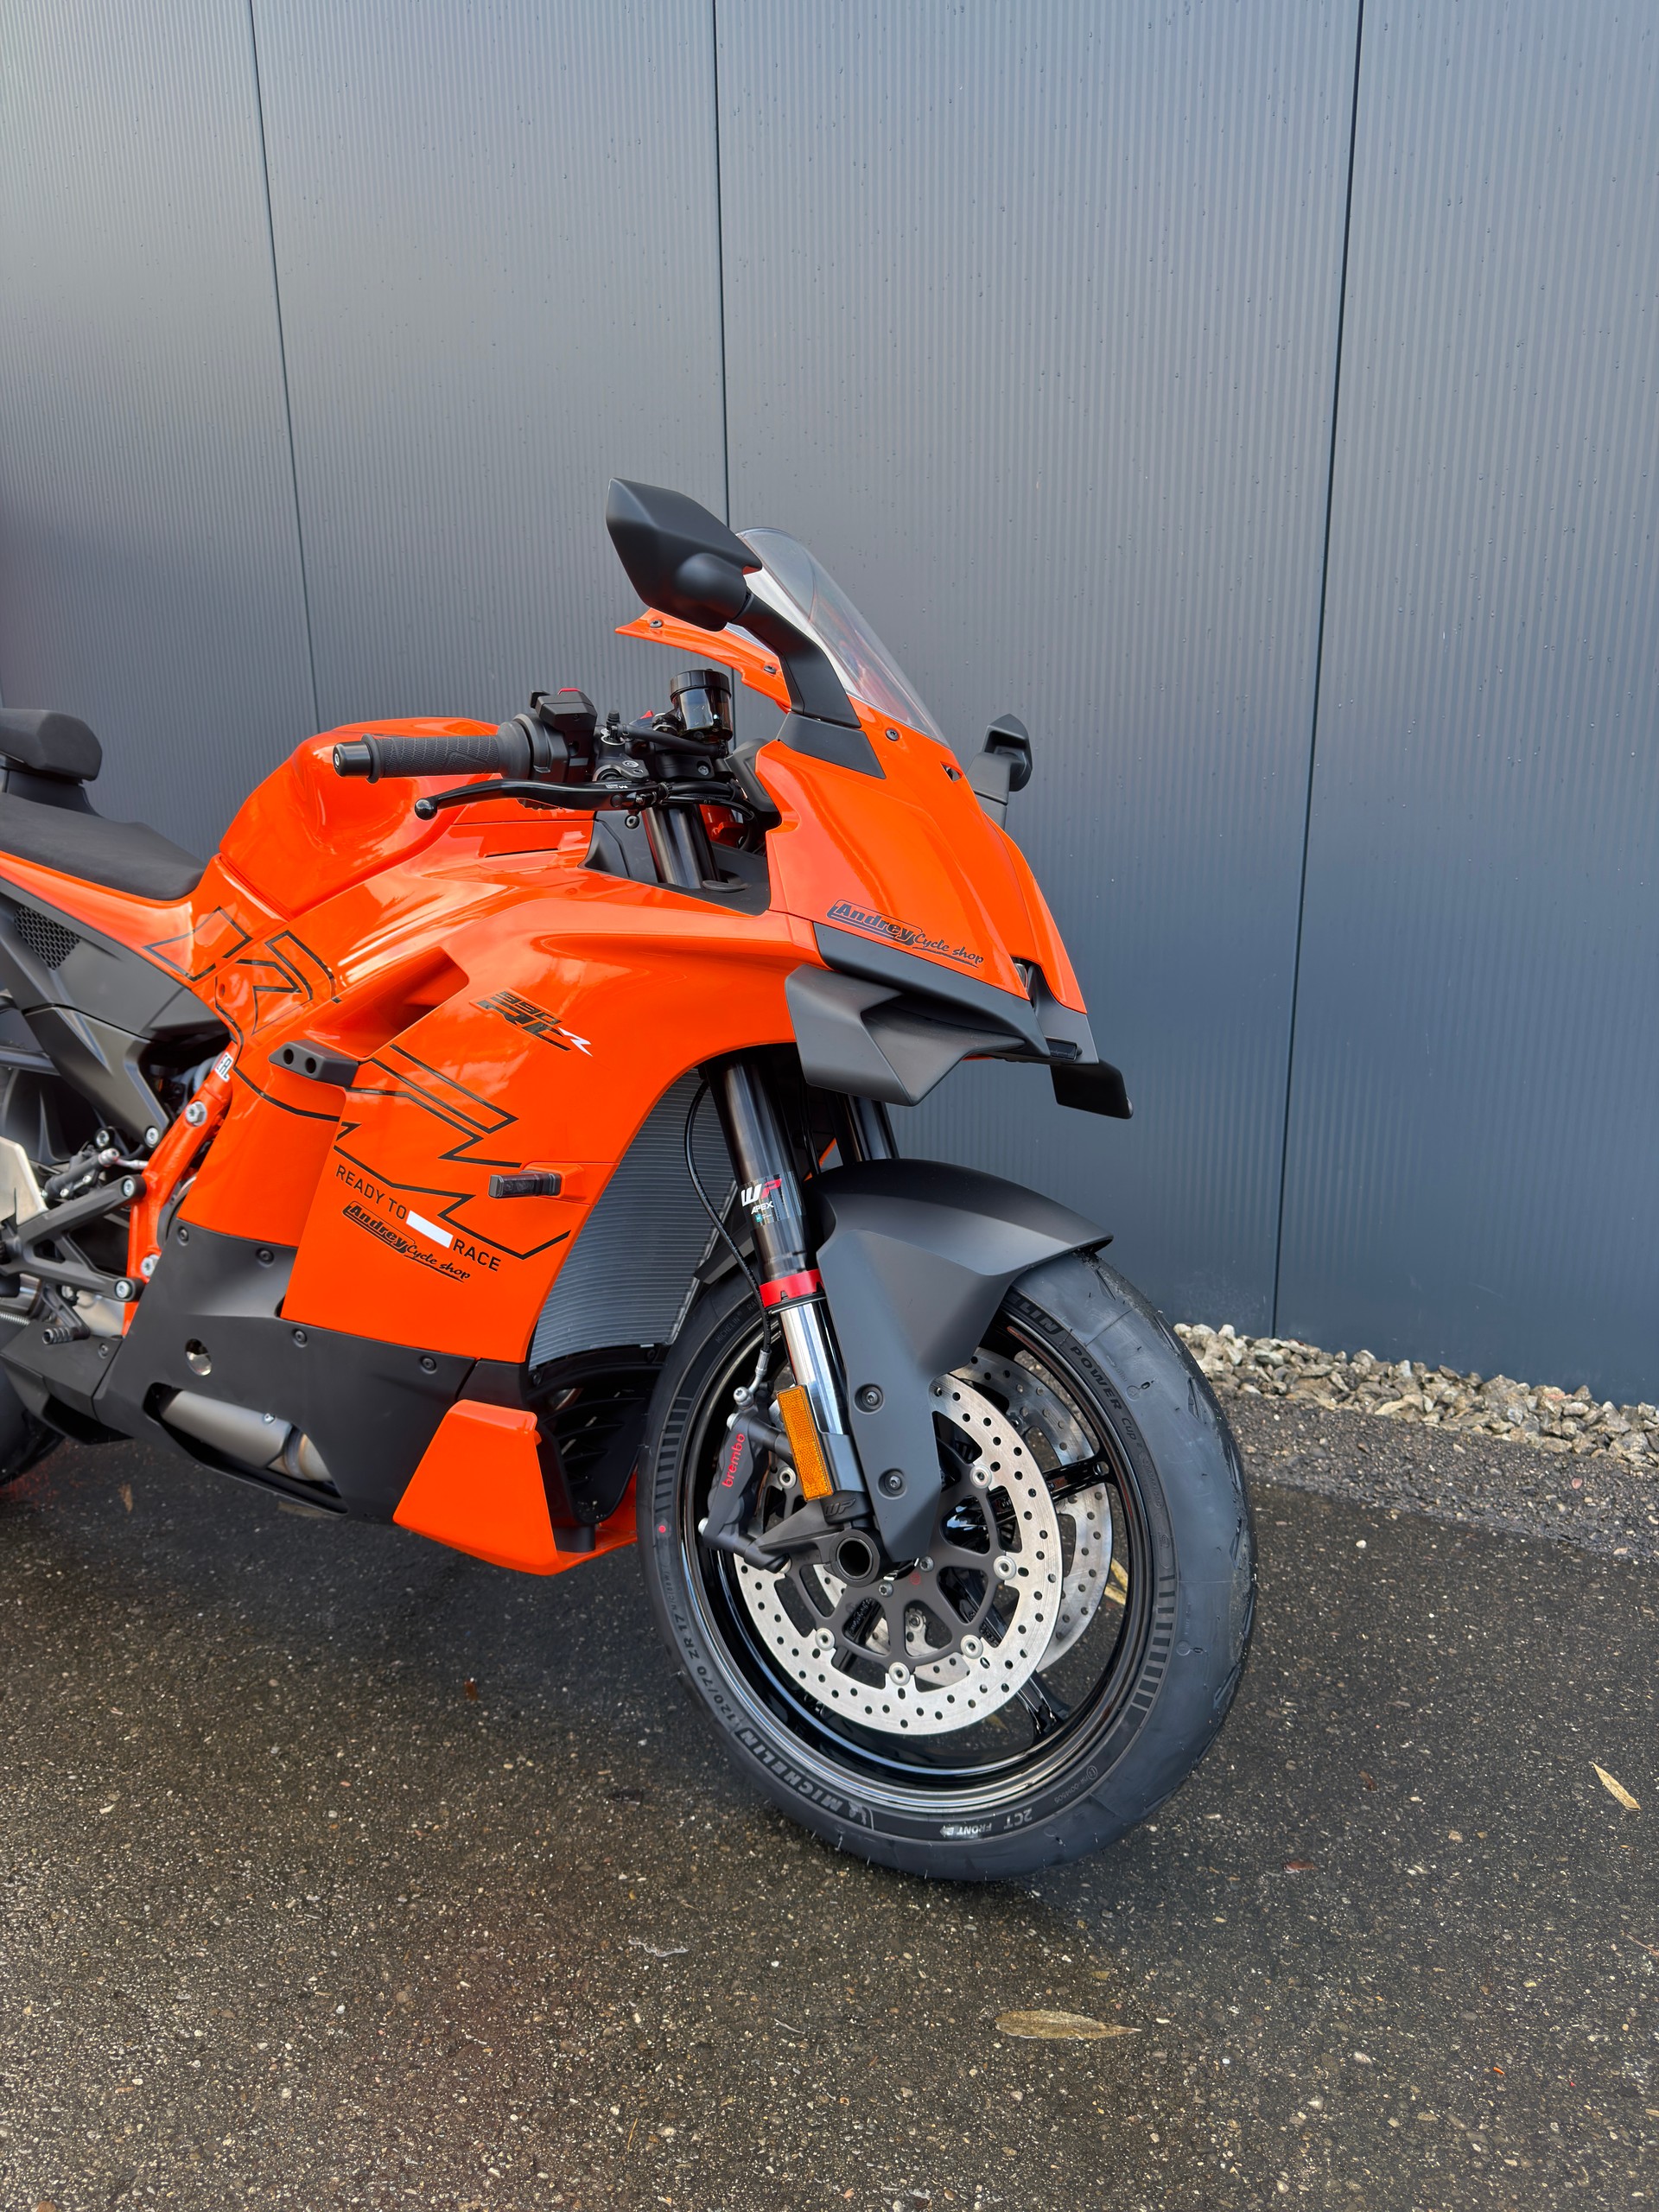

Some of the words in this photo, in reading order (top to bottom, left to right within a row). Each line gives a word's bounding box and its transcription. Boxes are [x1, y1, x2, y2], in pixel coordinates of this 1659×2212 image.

[833, 902, 914, 944] Andrey
[914, 932, 950, 951] Cycle
[952, 945, 984, 965] shop
[741, 1179, 782, 1206] WP
[751, 1200, 774, 1215] APEX
[335, 1164, 385, 1205] READY
[388, 1196, 408, 1220] TO
[452, 1239, 502, 1272] RACE
[346, 1203, 408, 1251] Andrey
[407, 1244, 436, 1267] Cycle
[439, 1262, 471, 1281] shop
[1005, 1293, 1059, 1333] ELIN
[1070, 1345, 1122, 1410] POWER
[722, 1433, 747, 1488] brembo
[824, 1498, 855, 1516] WP
[674, 1613, 690, 1632] 17
[683, 1637, 700, 1660] ZR
[696, 1666, 736, 1722] 120/70
[741, 1729, 844, 1813] MICHELIN
[957, 1821, 993, 1837] FRONT
[1002, 1807, 1033, 1830] 2CT
